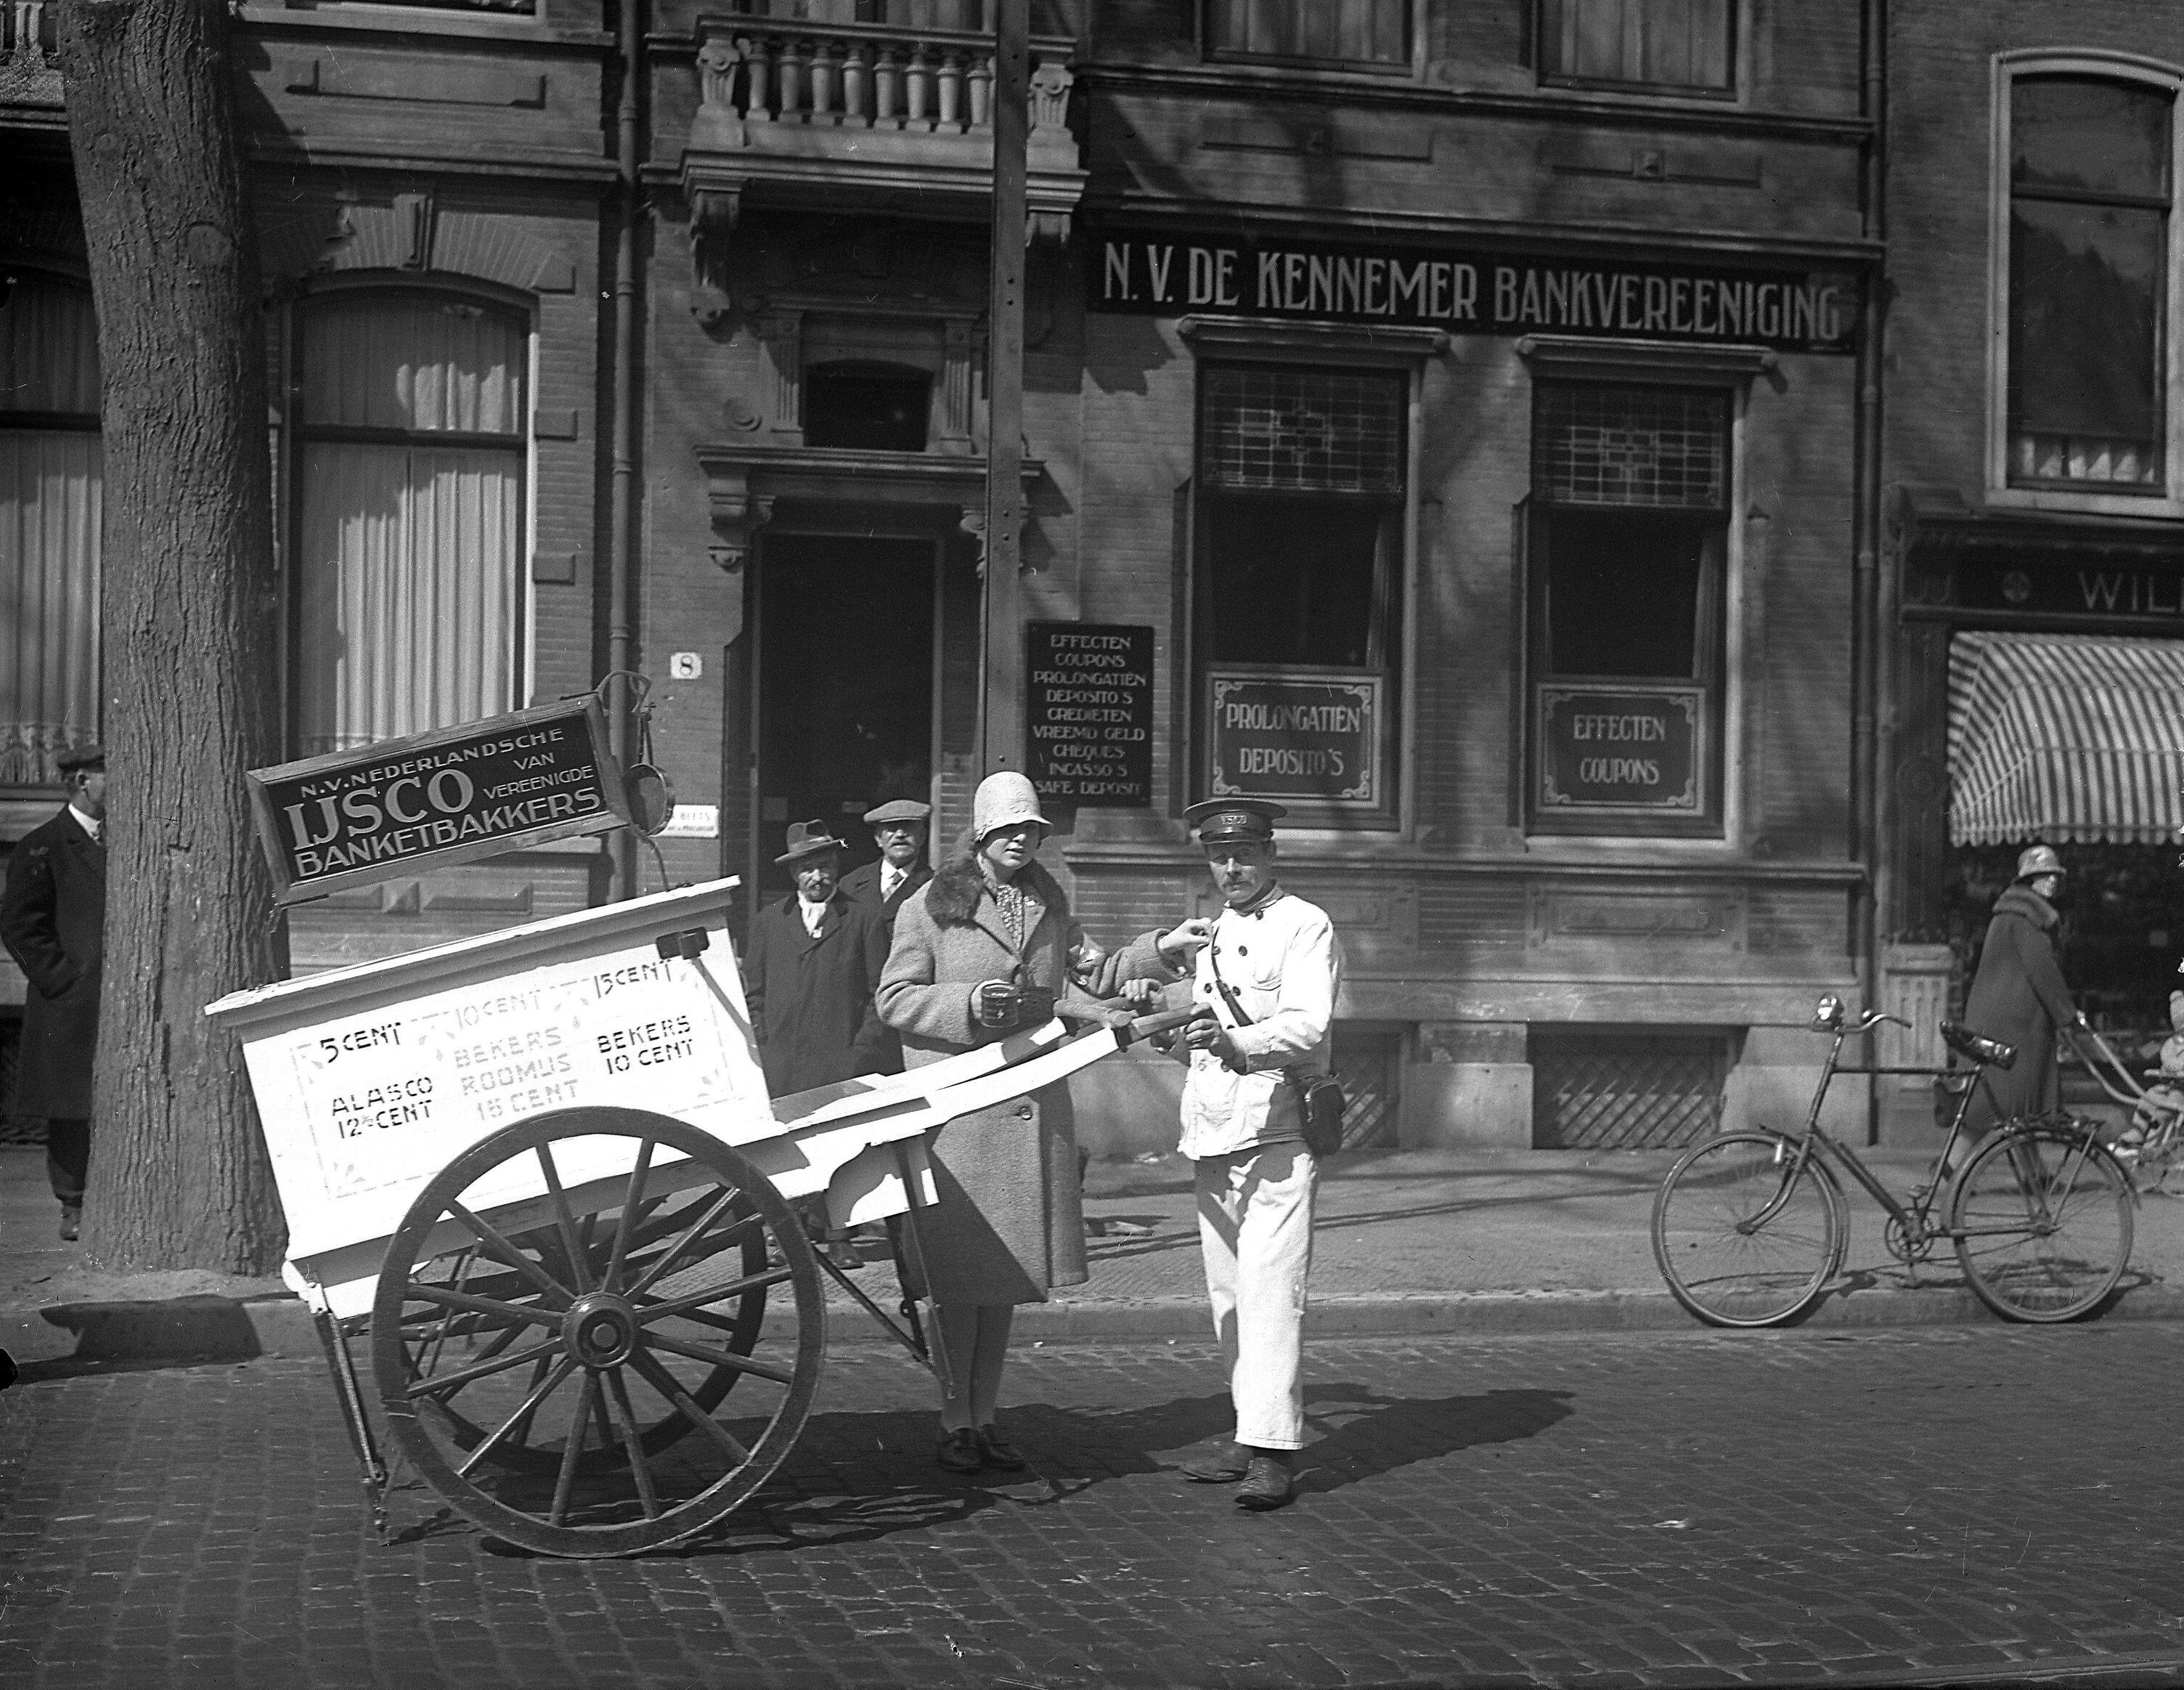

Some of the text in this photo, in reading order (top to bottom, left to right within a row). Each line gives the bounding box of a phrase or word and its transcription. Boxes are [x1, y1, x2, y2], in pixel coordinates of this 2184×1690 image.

[1188, 248, 1240, 305] DE
[1257, 251, 1478, 320] KENNEMER
[1494, 267, 1841, 341] BANKVEREENIGING
[2078, 570, 2184, 612] WIL
[1051, 634, 1132, 650] EFFECTEN
[680, 655, 693, 677] 8
[1055, 653, 1125, 667] COUPONS
[1047, 707, 1132, 722] CREDIETEN
[1573, 714, 1666, 742] EFFECTEN
[1032, 725, 1146, 741] VREEMD GELD
[513, 752, 555, 770] VAN
[1580, 757, 1661, 785] COUPONS
[483, 765, 595, 800] VEREENIGDE
[1034, 780, 1142, 795] SAFE DEPOSIT
[283, 768, 474, 850] IJSCO
[294, 787, 601, 878] BANKETBAKKERS
[453, 1025, 563, 1068] BEKERS
[597, 1015, 690, 1054] BEKERS
[606, 1039, 693, 1075] 10 CENT
[332, 1076, 433, 1117] ALASCO
[510, 1079, 578, 1113] CENT
[375, 1100, 433, 1129] CENT
